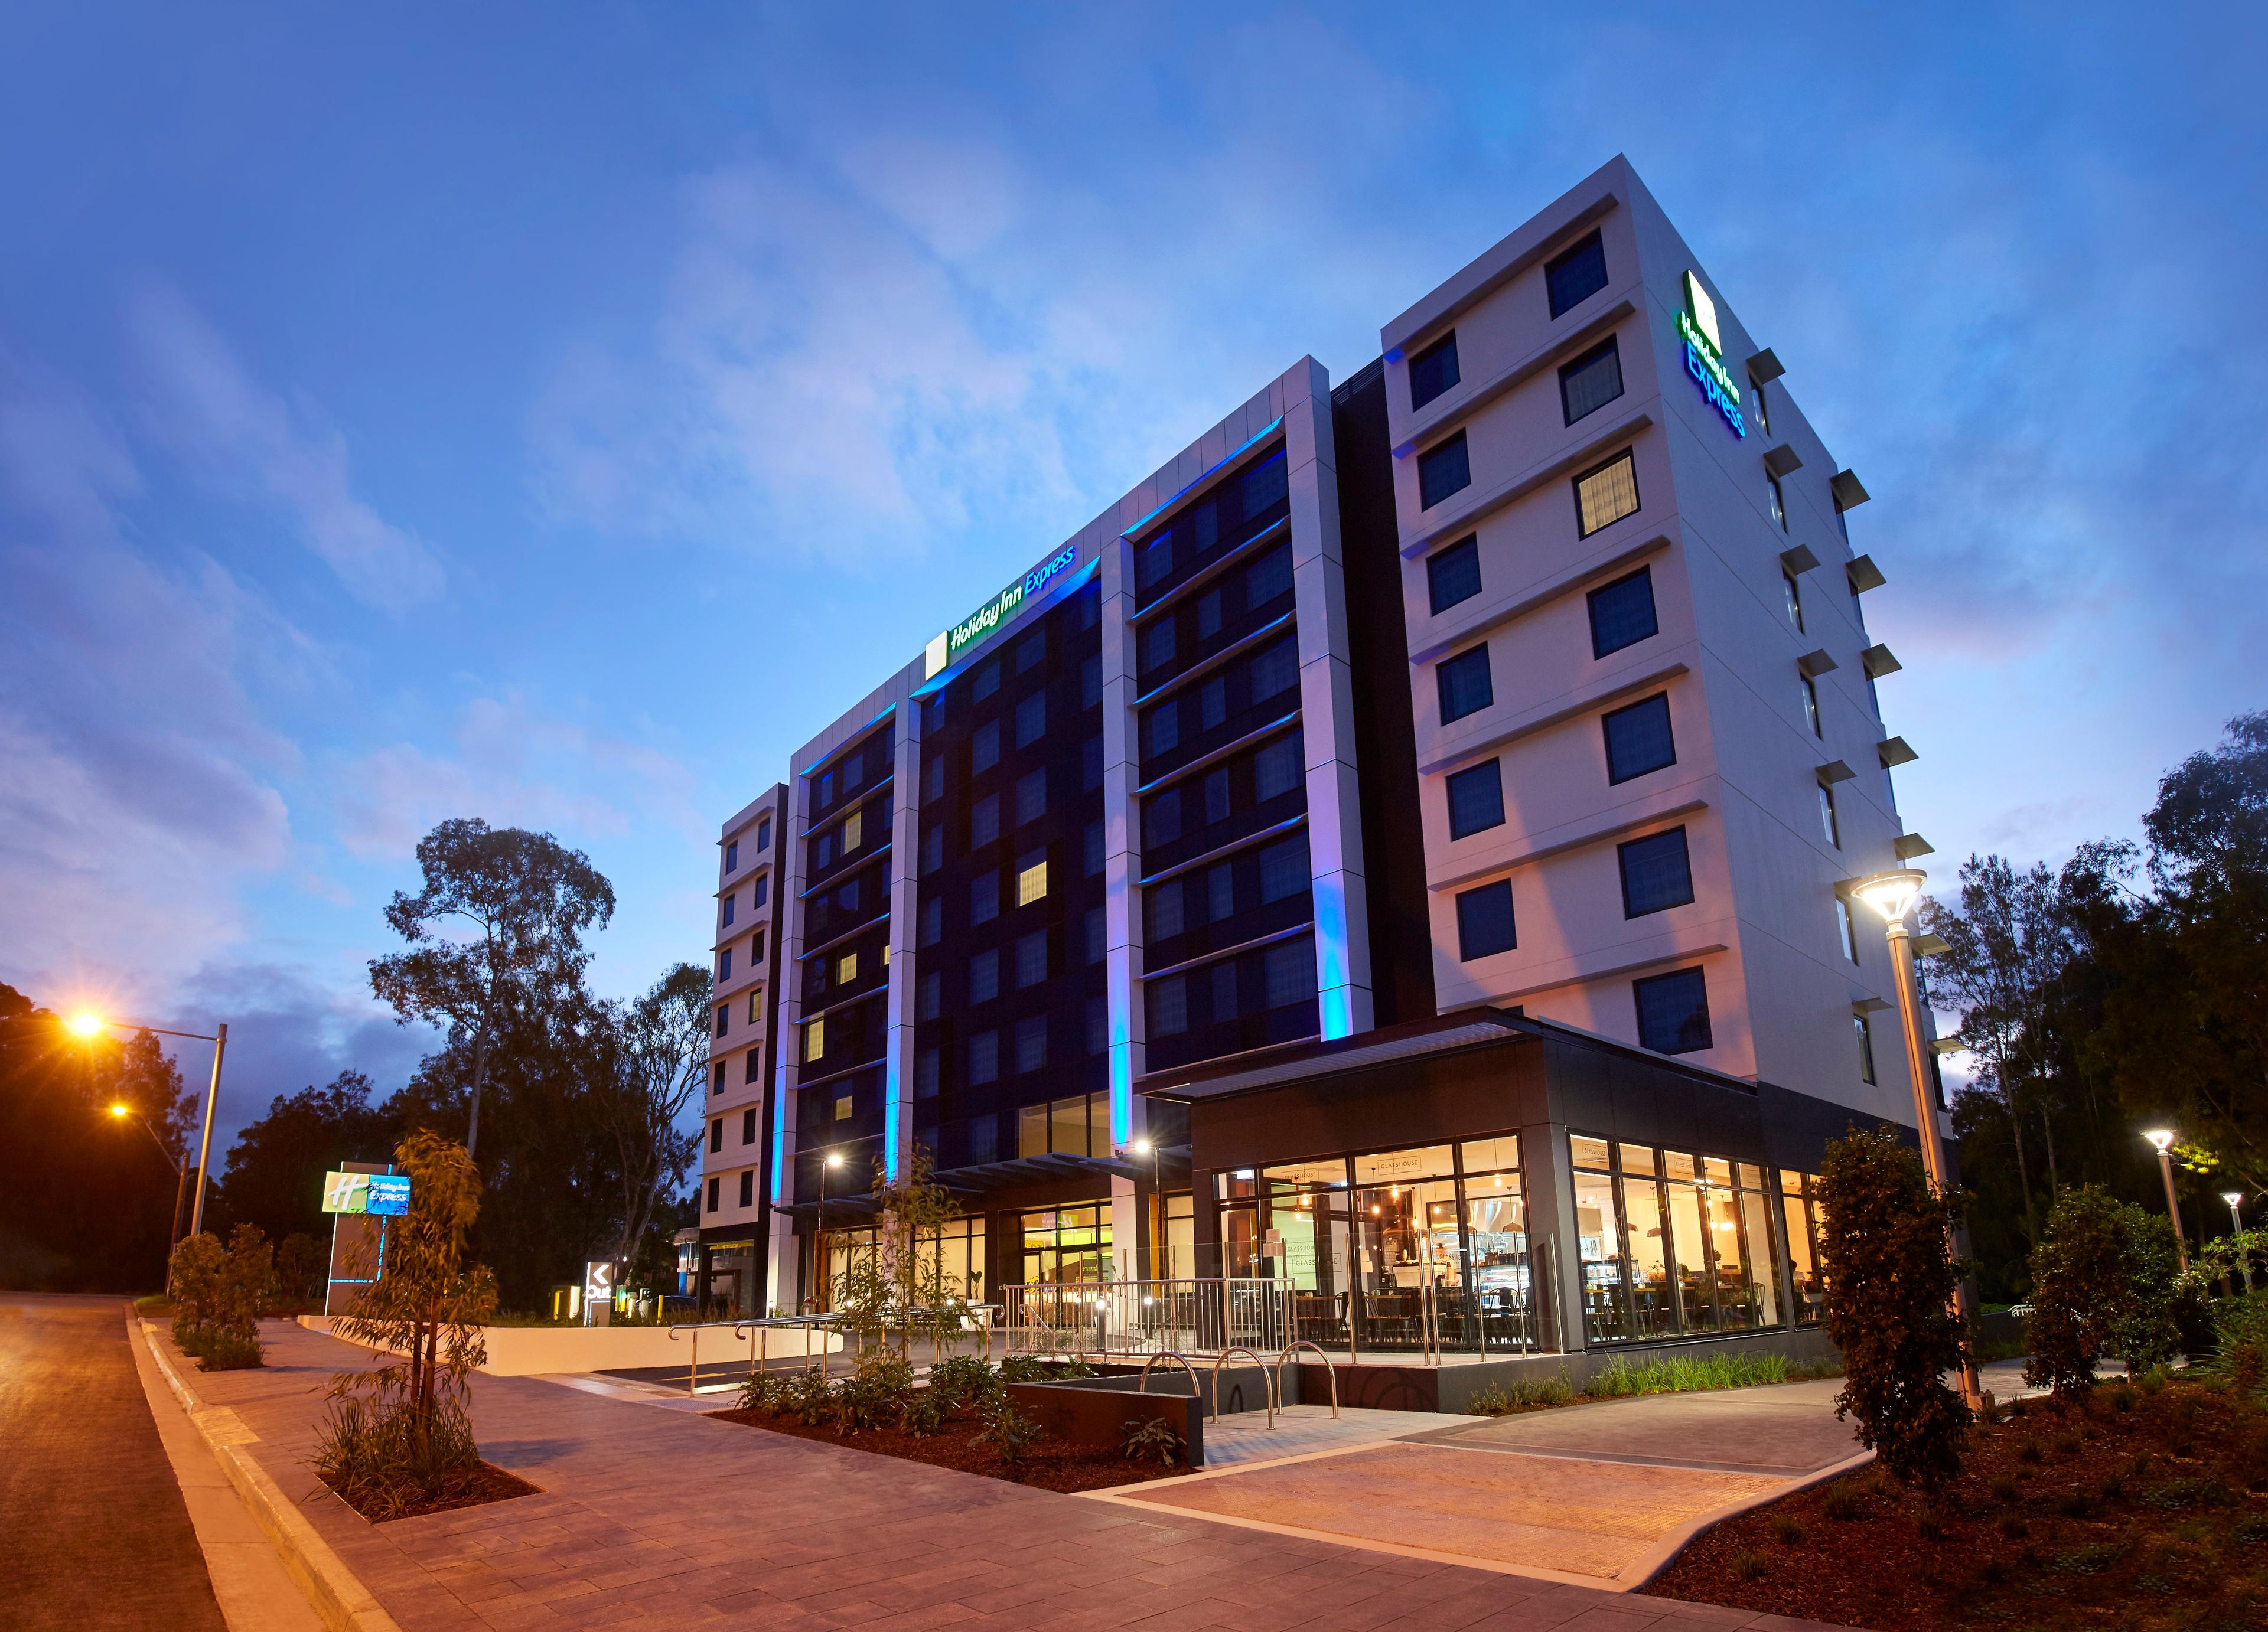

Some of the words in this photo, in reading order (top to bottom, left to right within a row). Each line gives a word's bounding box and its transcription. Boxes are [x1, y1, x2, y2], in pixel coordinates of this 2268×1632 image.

[1682, 311, 1723, 385] Holiday
[1722, 366, 1740, 404] Inn
[1687, 340, 1746, 438] Express
[951, 603, 999, 651] Holiday
[1000, 586, 1022, 614] Inn
[1025, 545, 1075, 595] Express
[1380, 1160, 1418, 1169] GLASSHOUSE
[369, 1190, 406, 1202] Express
[1295, 1258, 1338, 1267] GLASSE
[588, 1284, 611, 1299] Out
